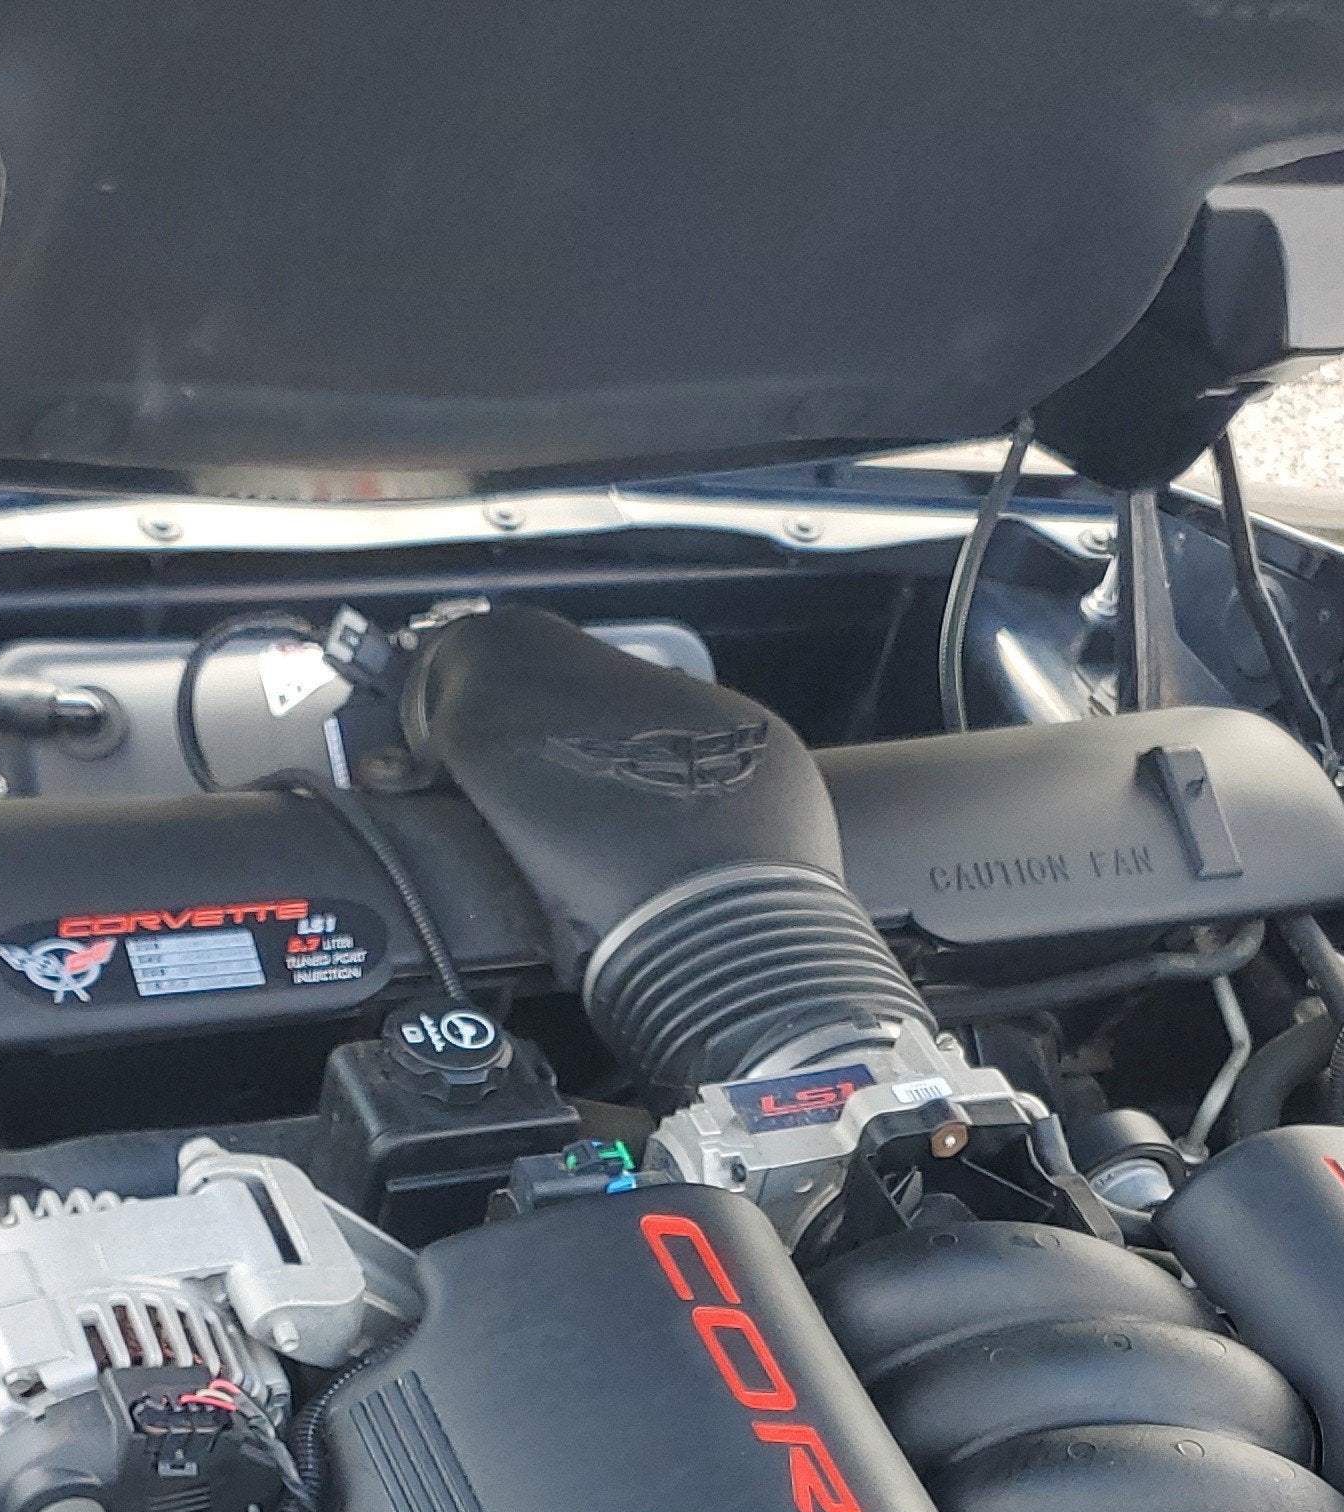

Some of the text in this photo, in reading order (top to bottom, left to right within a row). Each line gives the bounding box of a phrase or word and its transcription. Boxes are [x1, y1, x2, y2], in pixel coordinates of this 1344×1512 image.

[928, 845, 1154, 892] CAUTION FAN
[58, 899, 309, 937] CORVETTE
[760, 1081, 856, 1117] LS1
